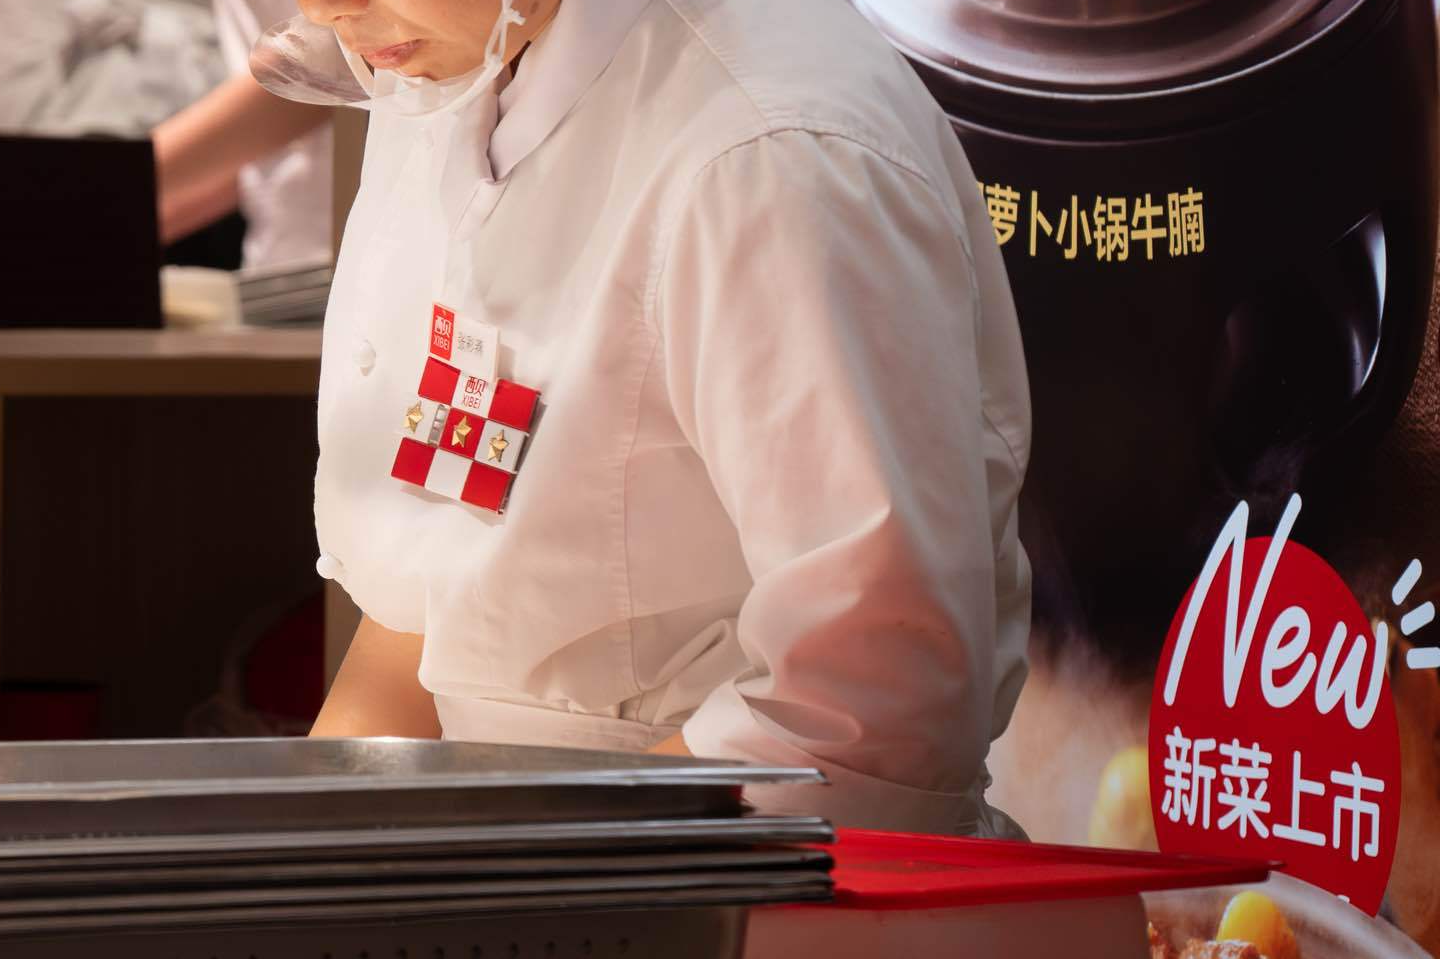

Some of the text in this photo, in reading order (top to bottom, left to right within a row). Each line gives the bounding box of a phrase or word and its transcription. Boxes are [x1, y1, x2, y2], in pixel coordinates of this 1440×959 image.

[977, 181, 1206, 262] 萝卜小锅牛腩
[433, 333, 451, 351] XIBEI
[463, 393, 481, 409] XIBEI
[1163, 492, 1389, 730] New
[1161, 726, 1385, 862] 新菜上市
